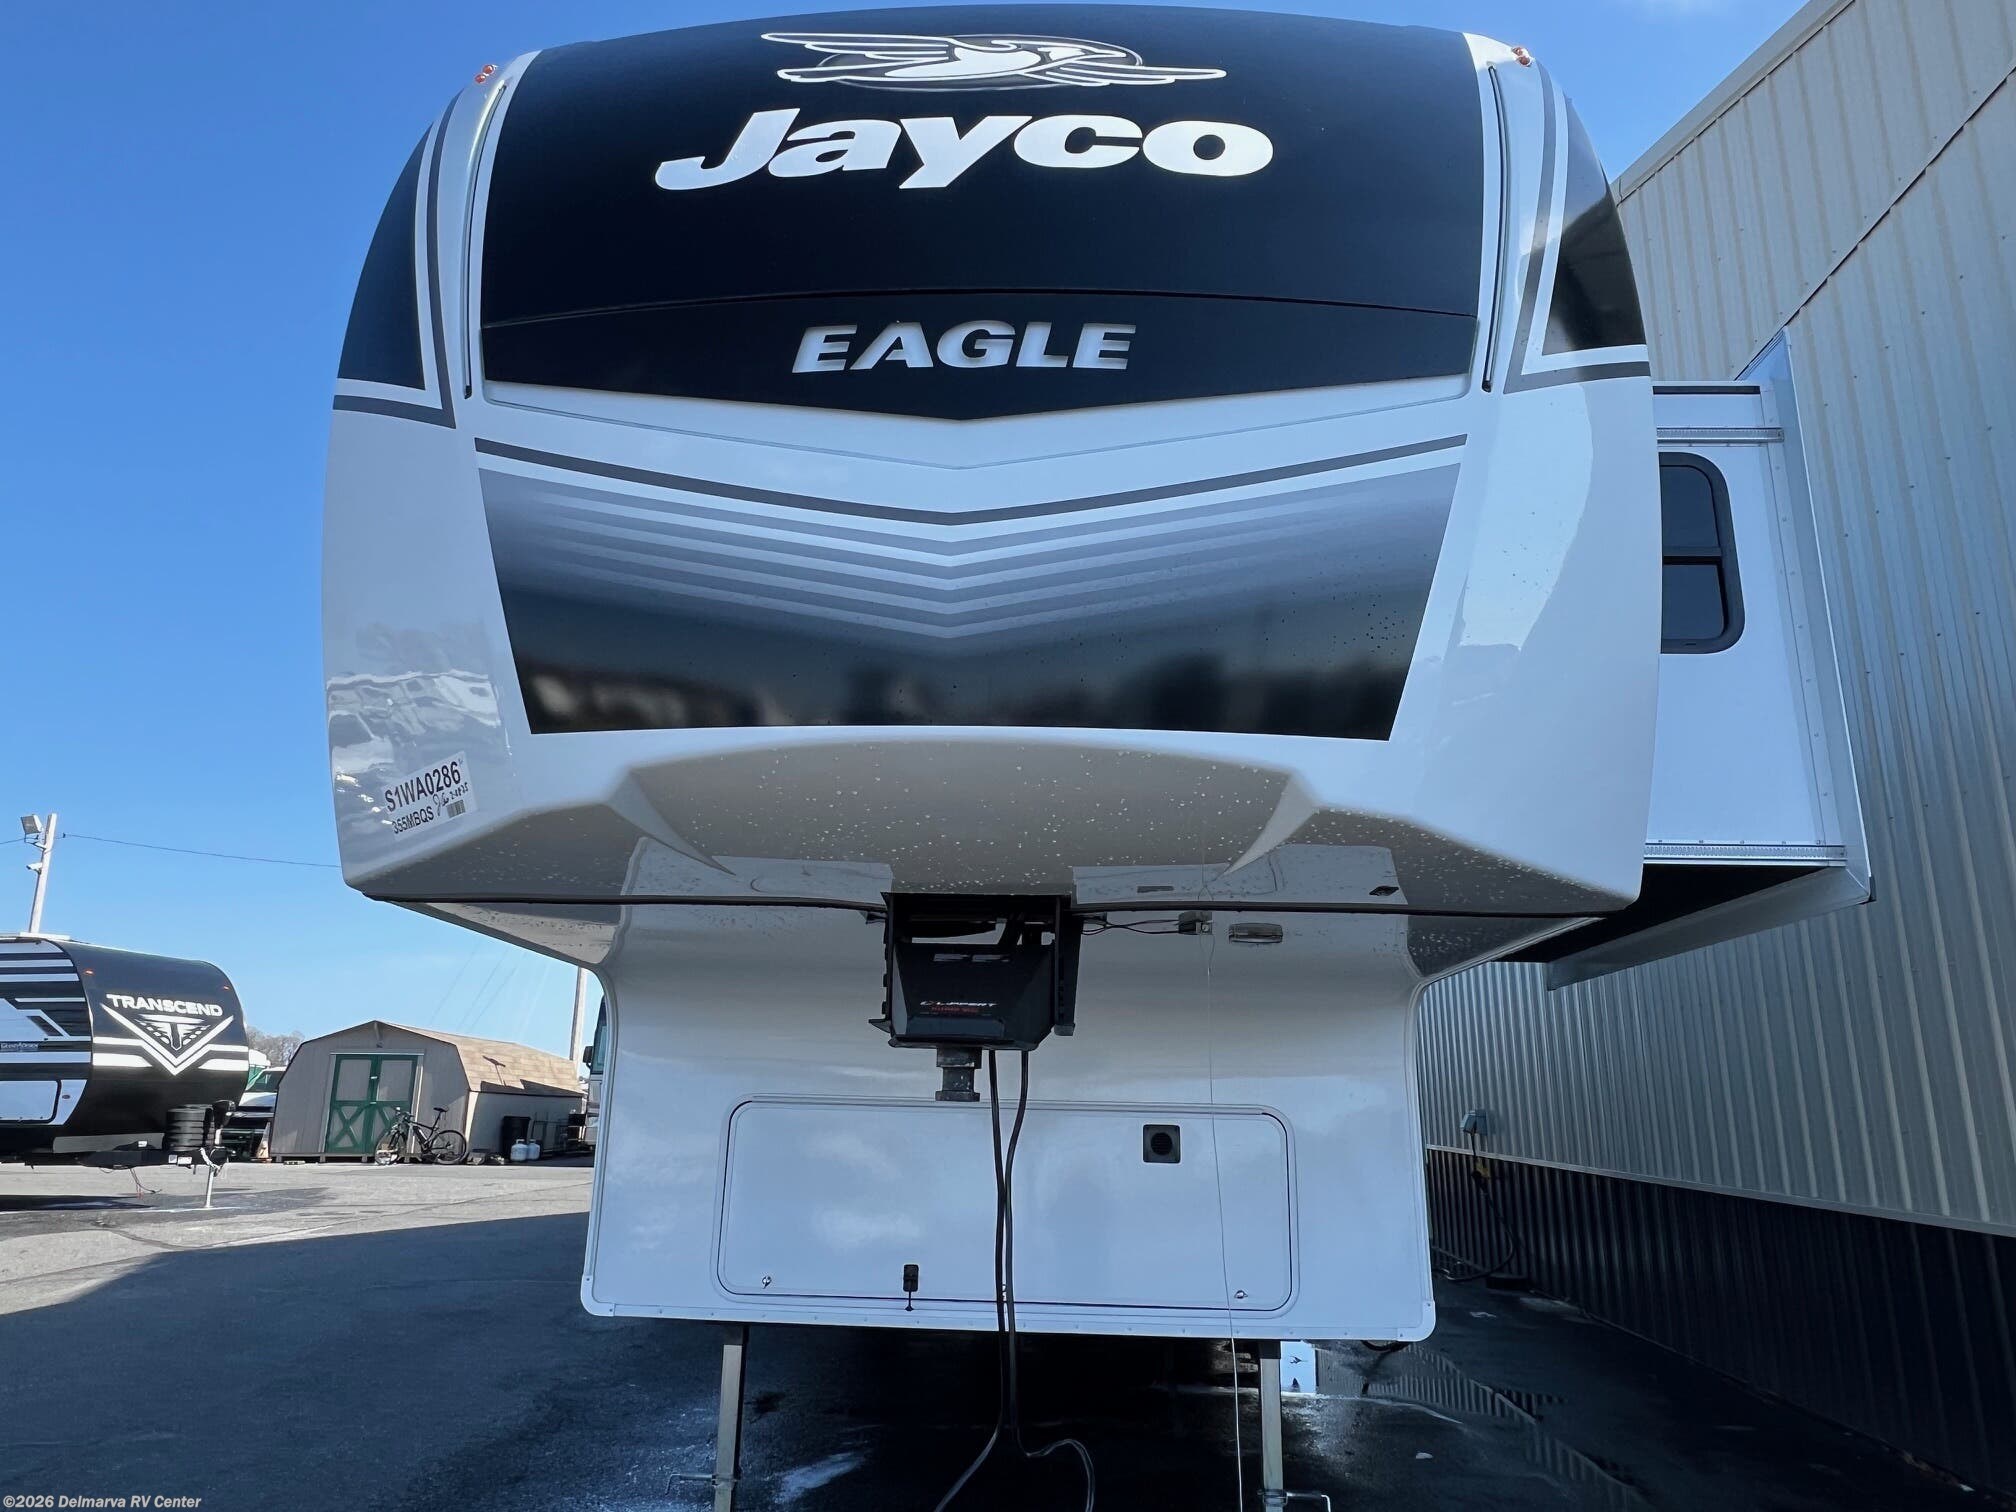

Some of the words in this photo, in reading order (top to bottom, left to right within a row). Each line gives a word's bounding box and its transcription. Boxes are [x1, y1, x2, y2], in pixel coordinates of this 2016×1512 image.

[654, 108, 1274, 190] Jayco
[792, 320, 1136, 373] EAGLE
[384, 761, 461, 812] S1WA0286
[106, 993, 223, 1017] TRANSCEND
